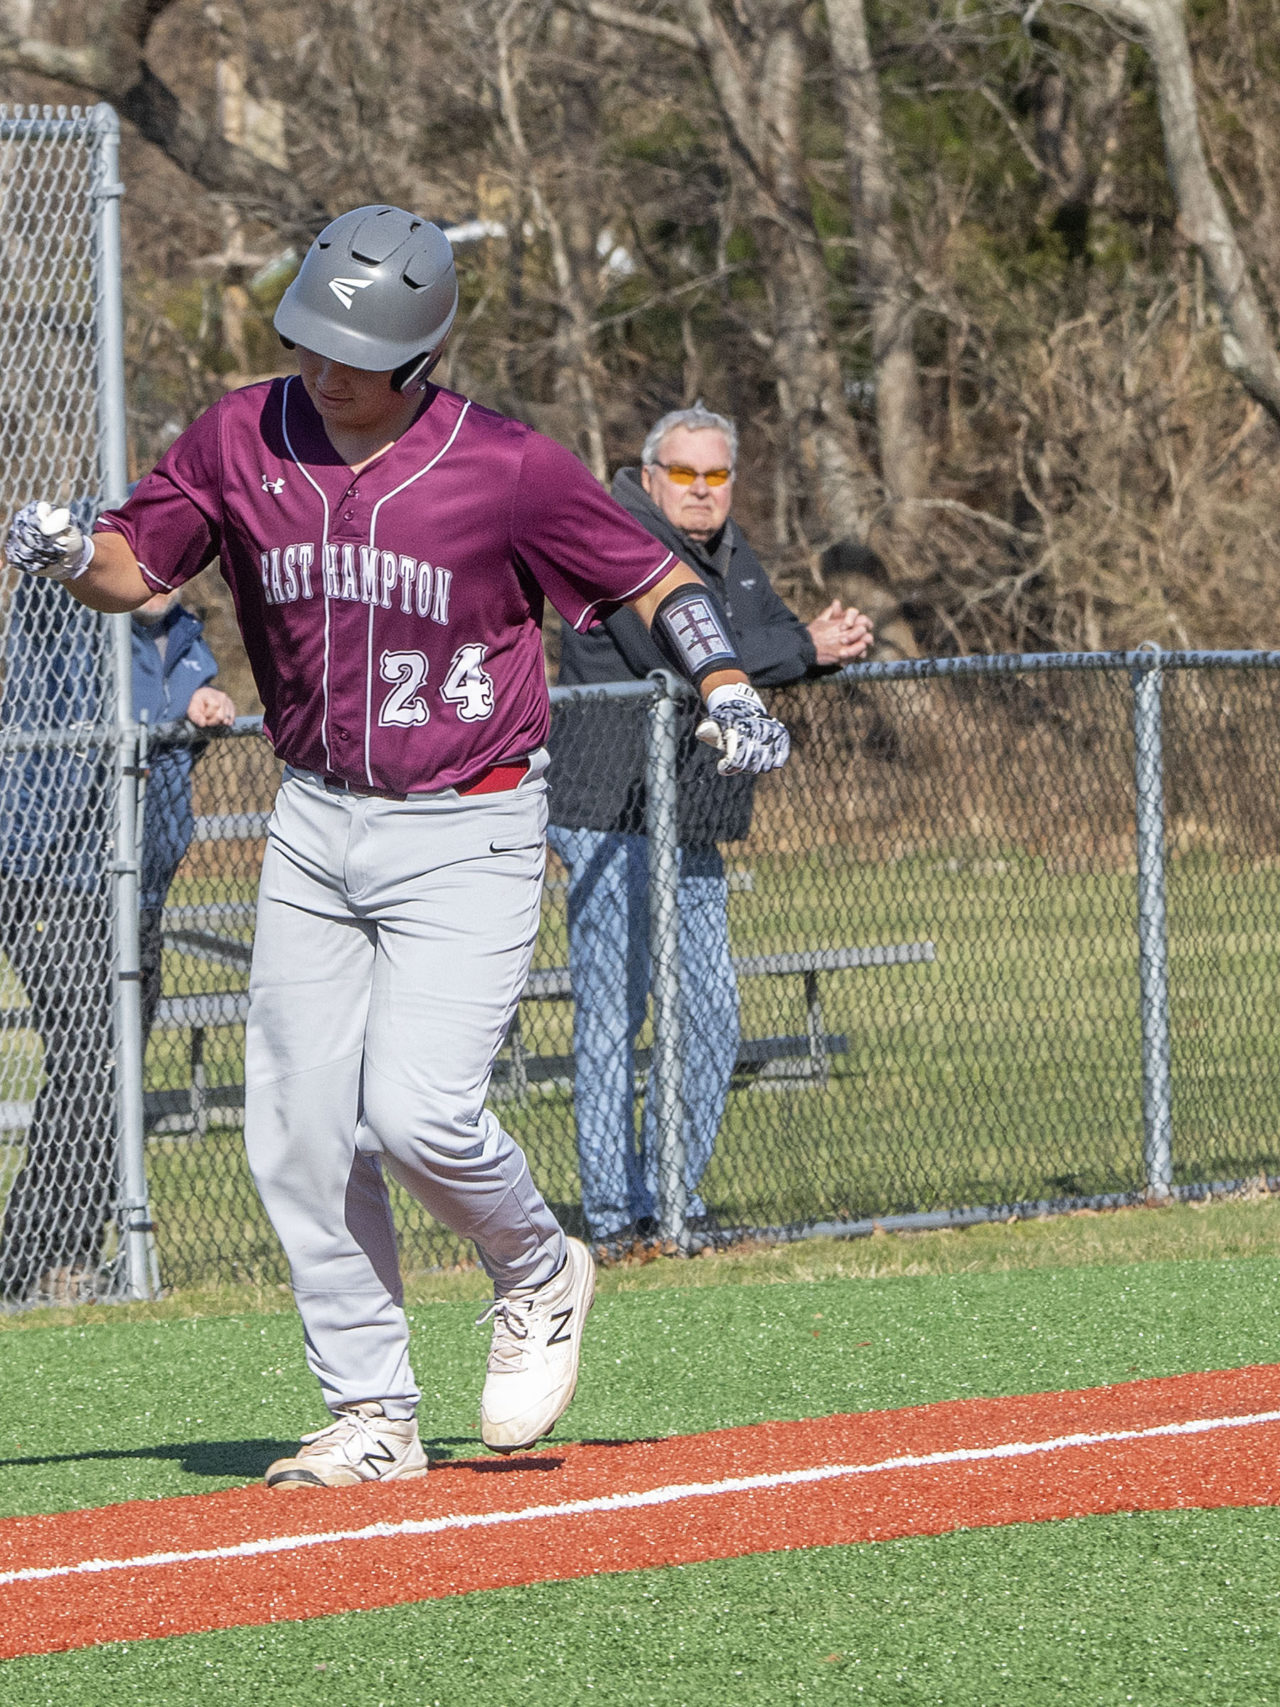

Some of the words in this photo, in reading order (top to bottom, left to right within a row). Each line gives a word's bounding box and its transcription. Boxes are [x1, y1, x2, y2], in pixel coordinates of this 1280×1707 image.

[261, 543, 315, 605] EAST
[323, 543, 453, 626] HAMPTON
[378, 642, 496, 727] 24
